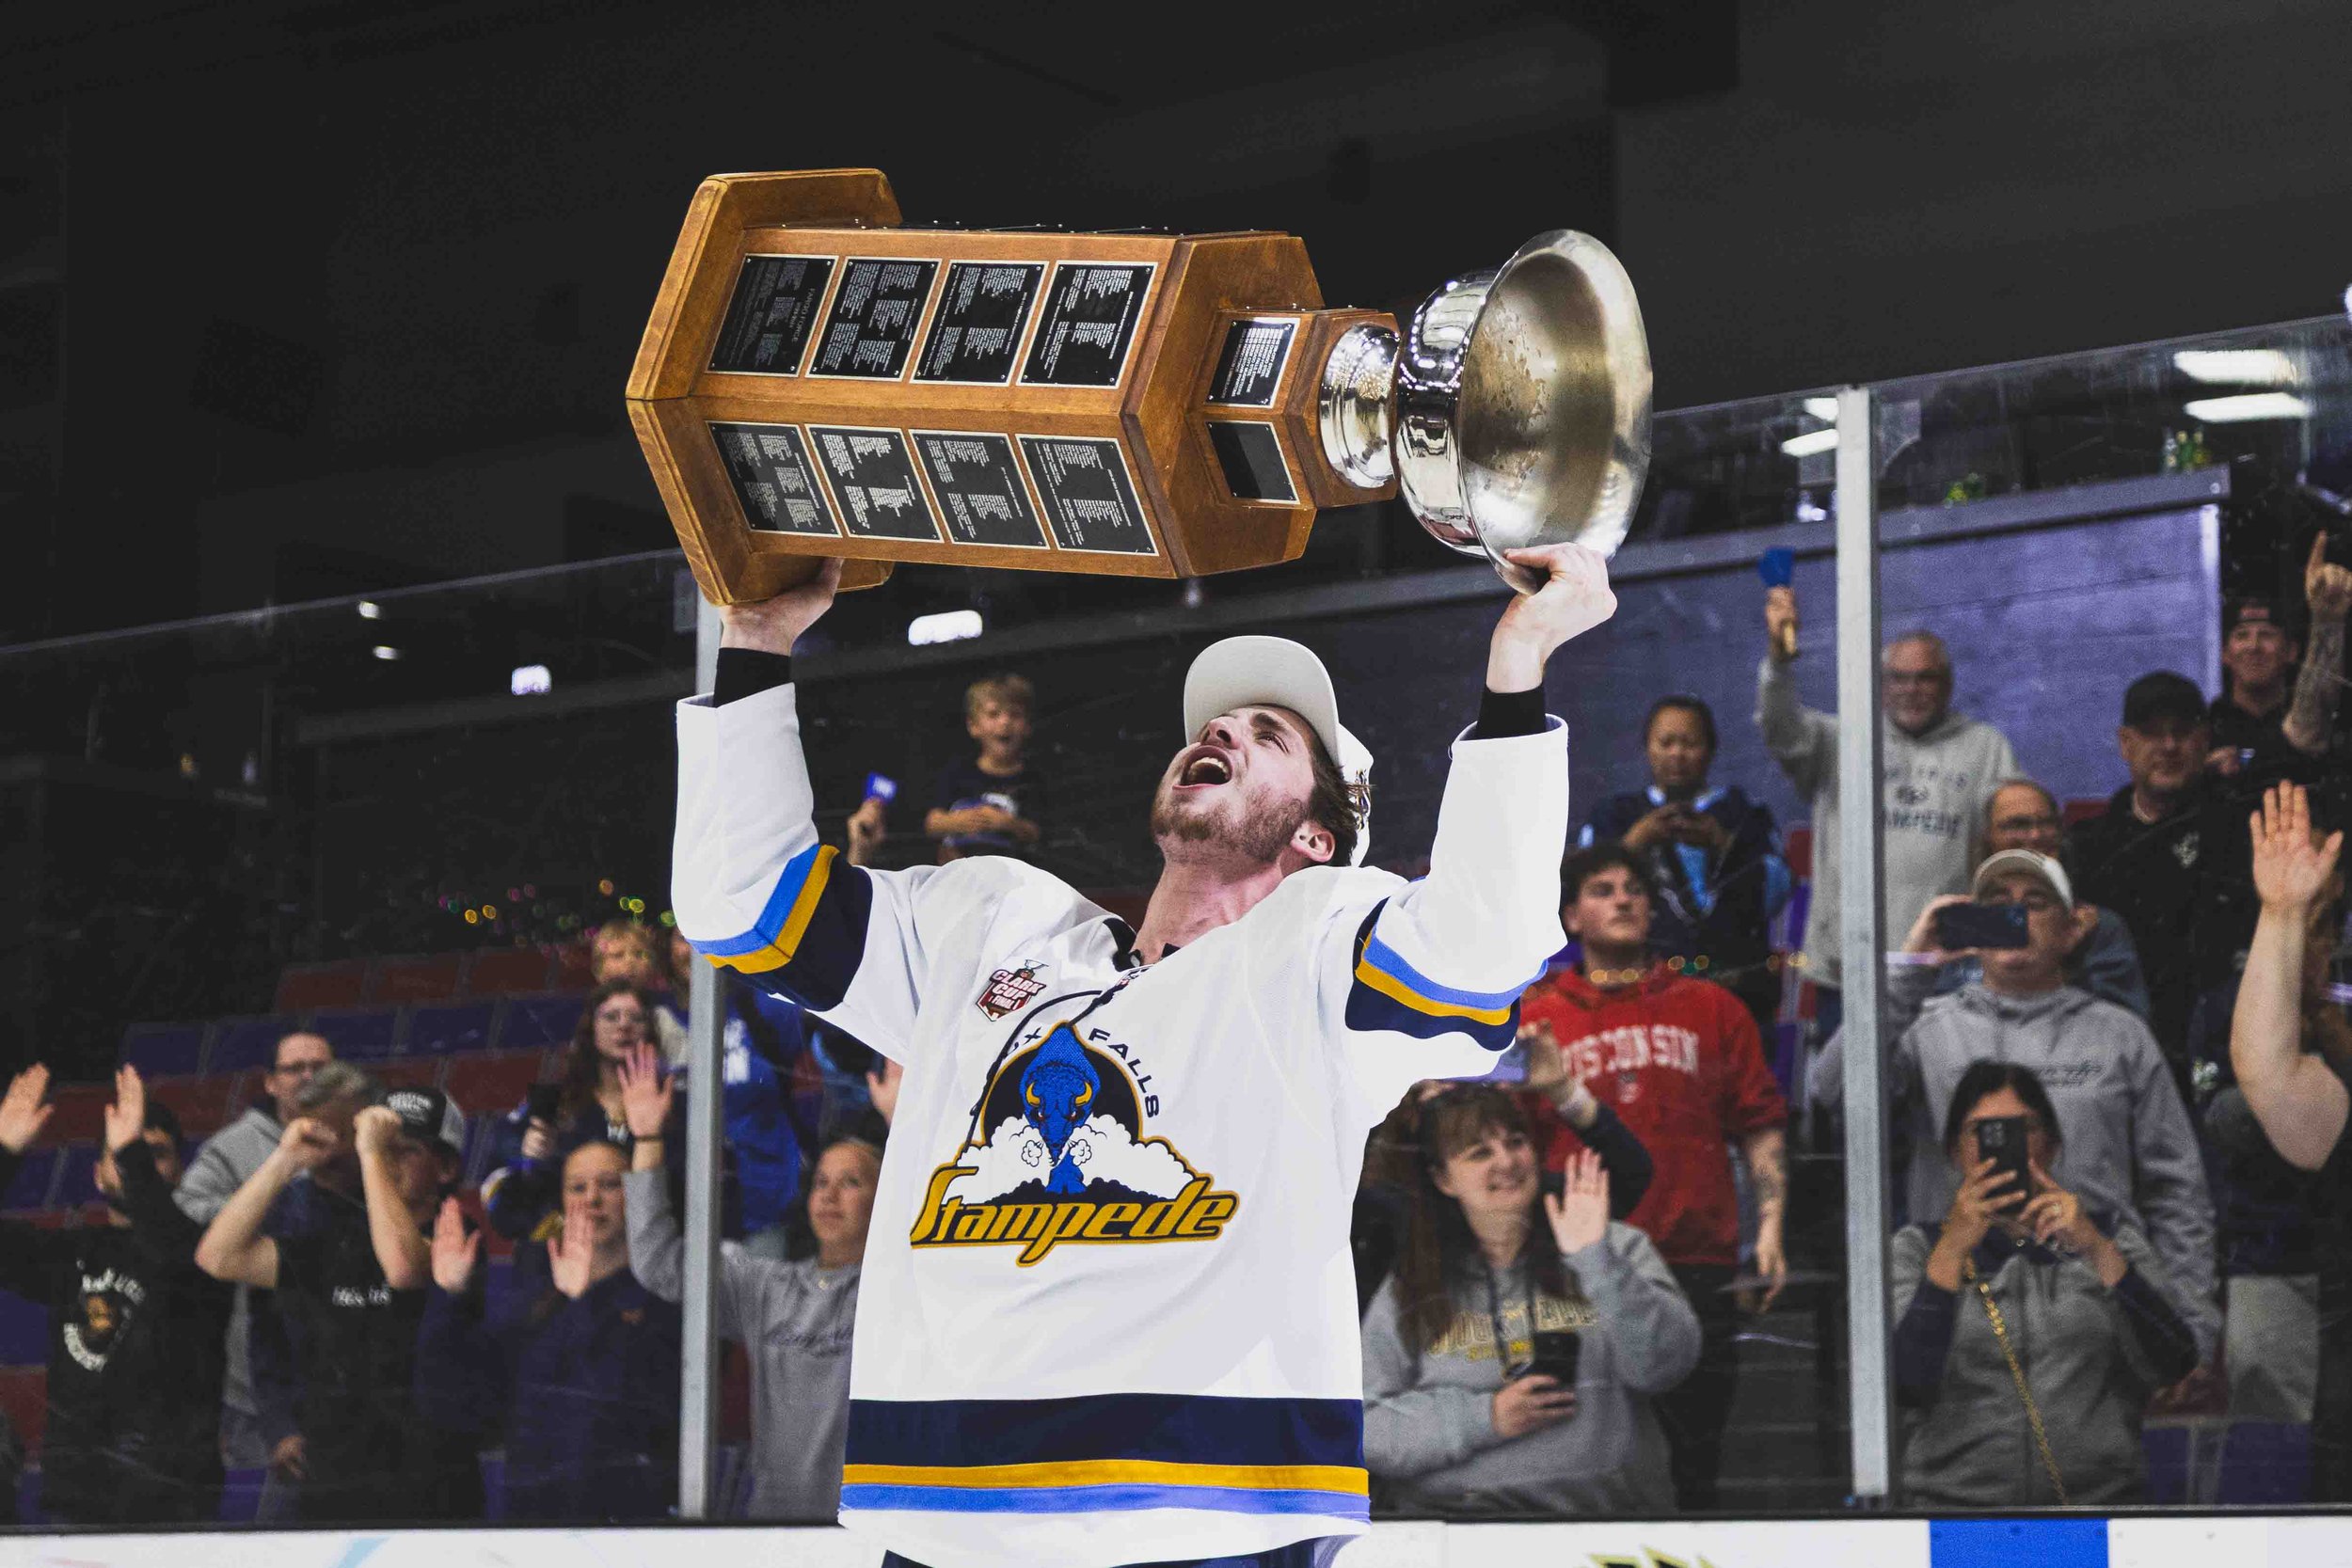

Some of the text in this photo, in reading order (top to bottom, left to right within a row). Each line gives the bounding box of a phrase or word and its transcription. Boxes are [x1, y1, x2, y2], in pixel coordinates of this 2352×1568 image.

[991, 969, 1045, 994] CLARK
[992, 982, 1028, 1000] CUP
[992, 995, 1016, 1009] FINAL
[1562, 1022, 1700, 1077] ISCONSIN
[1089, 1027, 1160, 1118] FALLS
[911, 1165, 1238, 1265] Stampede
